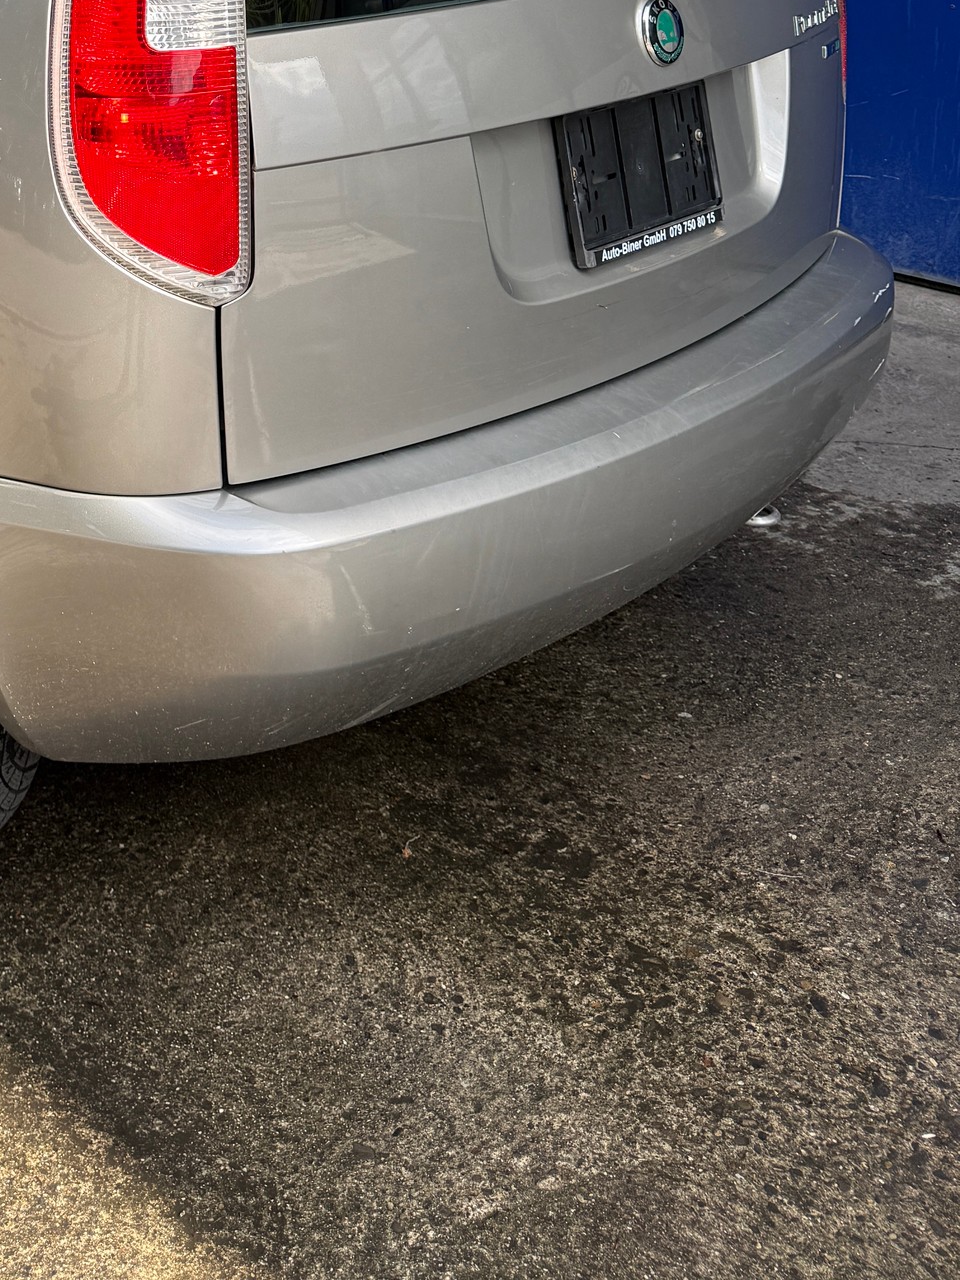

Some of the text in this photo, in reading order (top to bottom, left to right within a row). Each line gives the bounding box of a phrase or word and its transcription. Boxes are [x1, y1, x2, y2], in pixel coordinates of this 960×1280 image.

[602, 211, 716, 262] Auto-Biner GmbH 079 750 80 15
